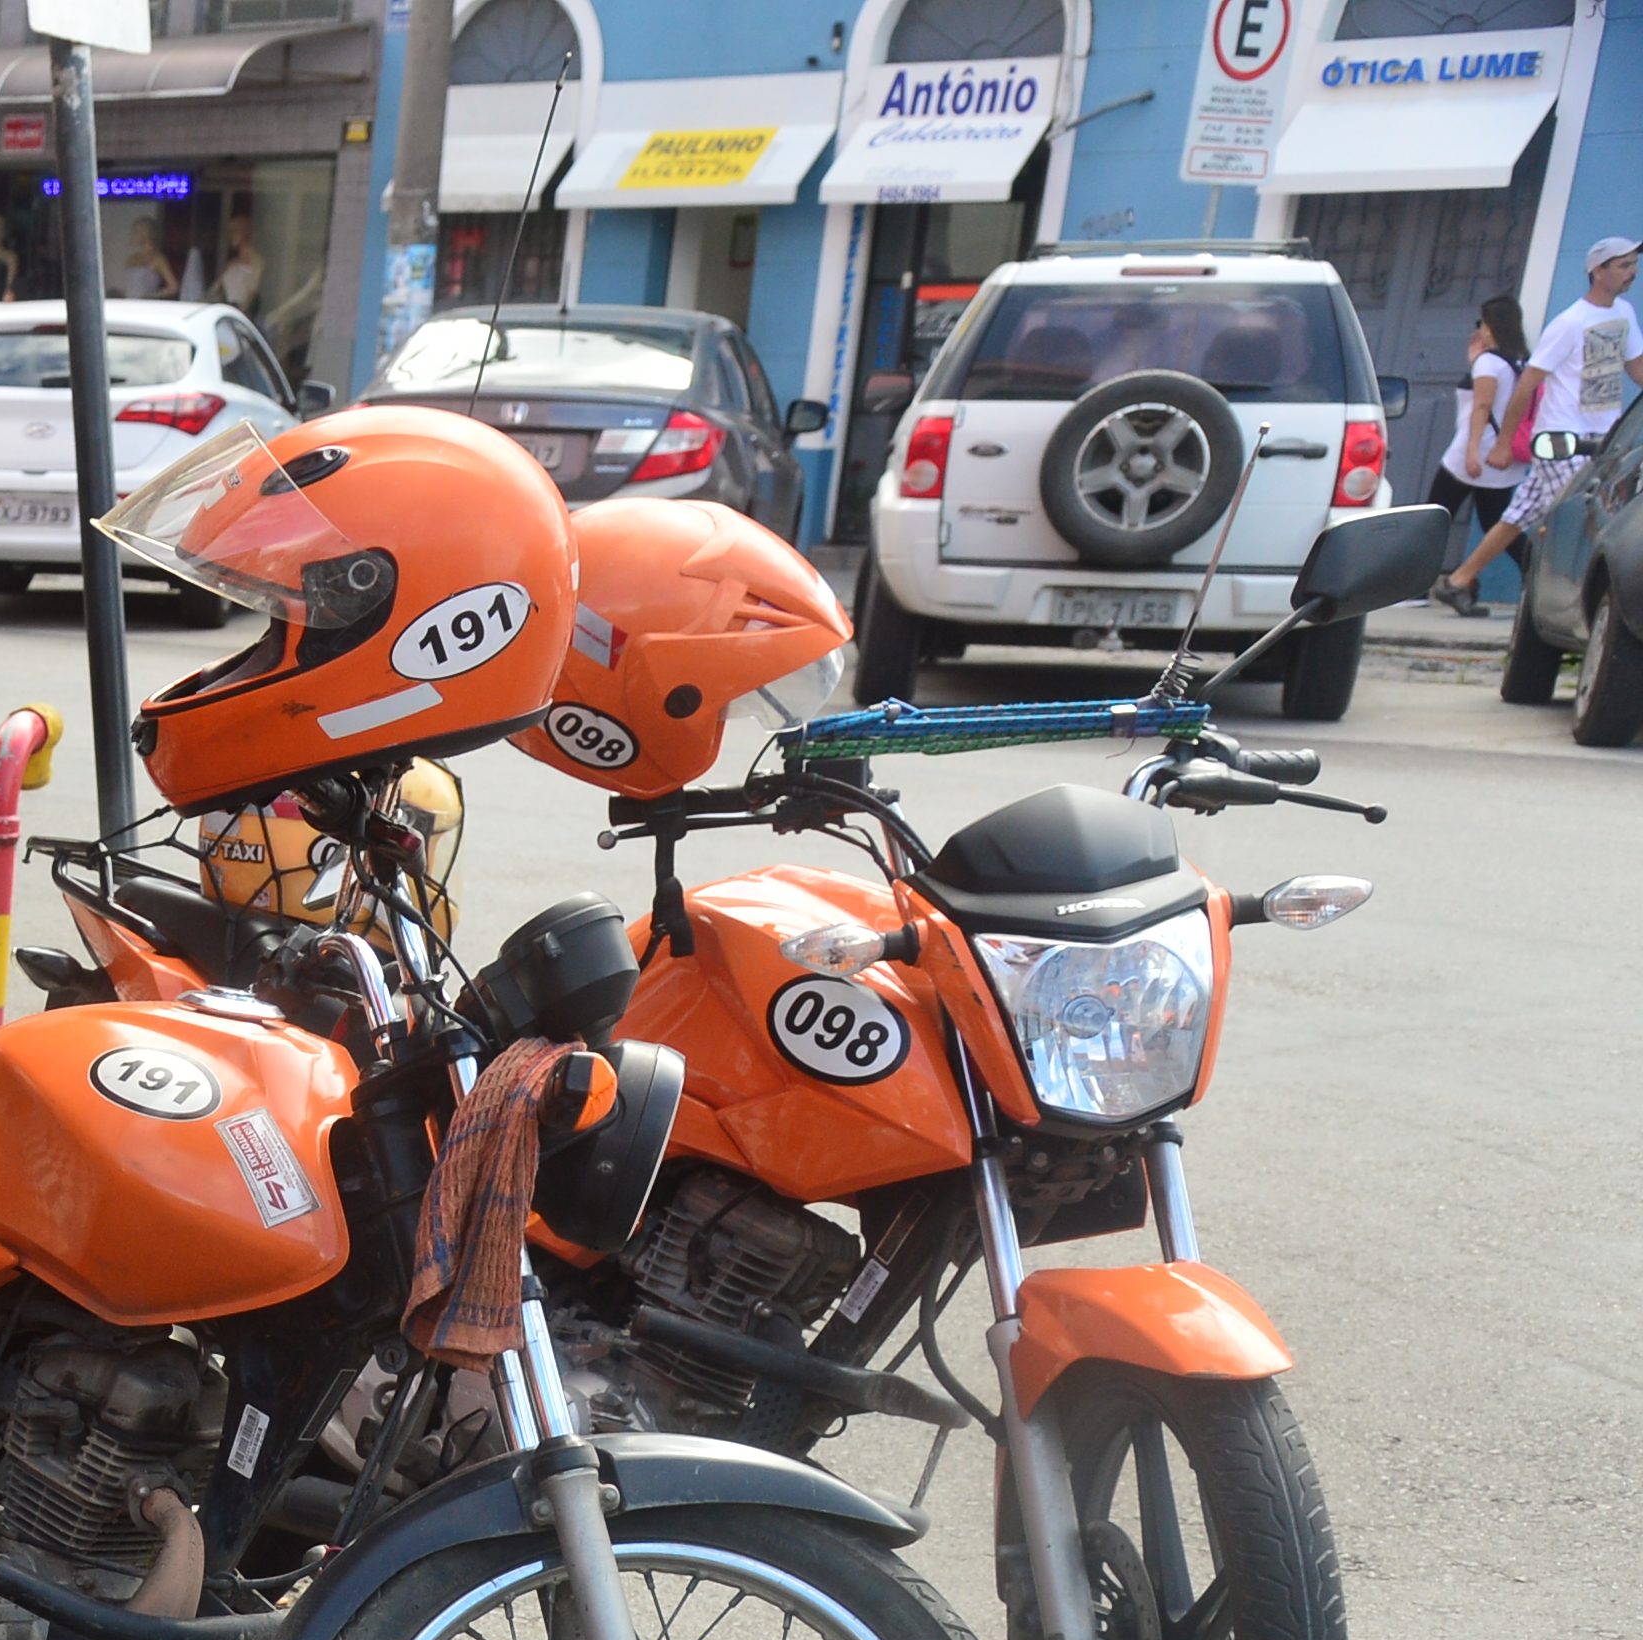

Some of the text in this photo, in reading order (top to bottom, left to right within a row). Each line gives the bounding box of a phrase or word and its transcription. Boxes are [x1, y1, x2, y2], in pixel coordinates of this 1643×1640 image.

[1235, 0, 1269, 57] E
[879, 64, 1040, 117] Antônio
[1322, 50, 1542, 87] ÓTICA LUME
[645, 134, 765, 157] PAULINHO
[419, 594, 515, 660] 191
[553, 710, 630, 761] 098
[222, 838, 265, 862] TÁXI
[1056, 899, 1146, 915] HONDA
[784, 991, 890, 1067] 098
[116, 1058, 203, 1105] 191
[241, 1122, 271, 1165] VISTORIADO
[252, 1163, 278, 1180] 2015
